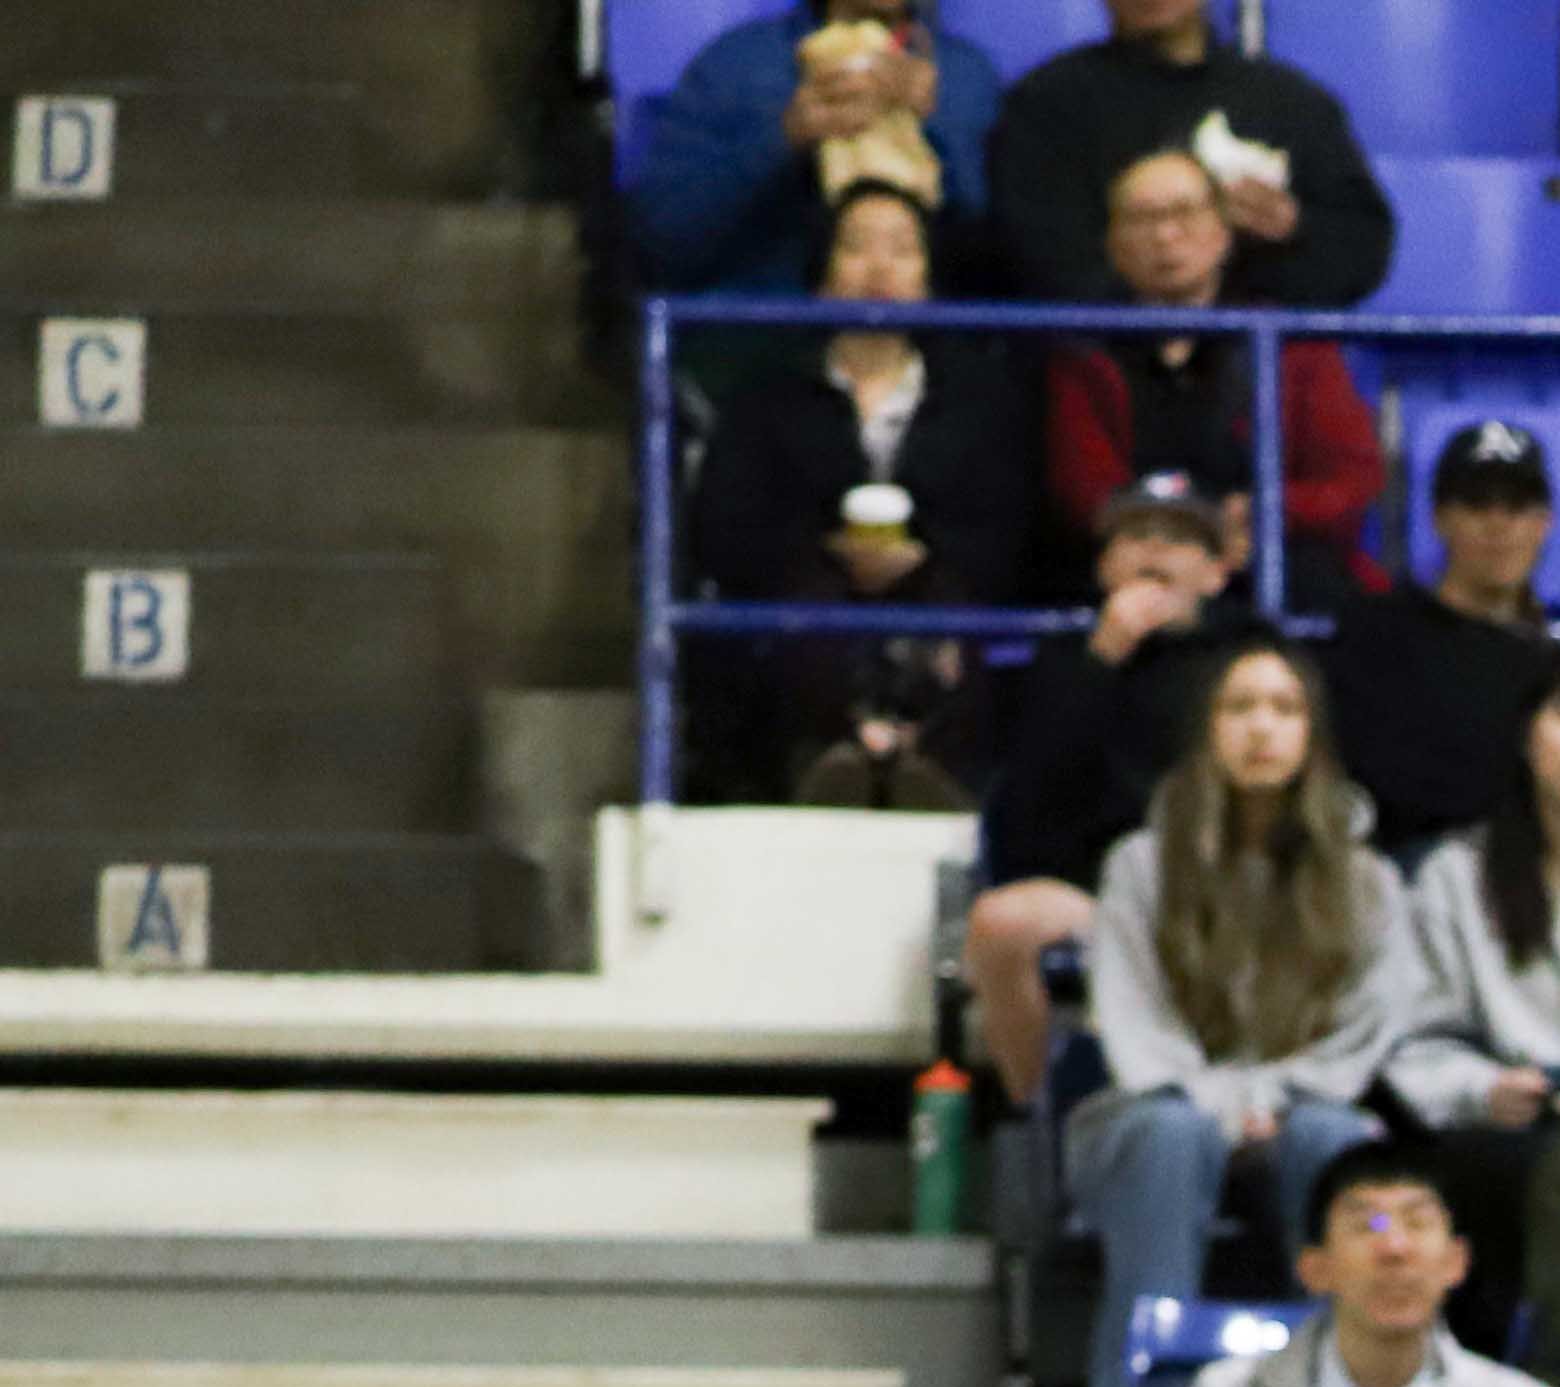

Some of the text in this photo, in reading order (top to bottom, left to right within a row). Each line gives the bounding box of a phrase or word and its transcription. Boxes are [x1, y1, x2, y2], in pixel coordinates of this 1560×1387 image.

[39, 108, 93, 186] D
[66, 334, 121, 417] C
[108, 582, 164, 670] B
[129, 868, 181, 957] A
